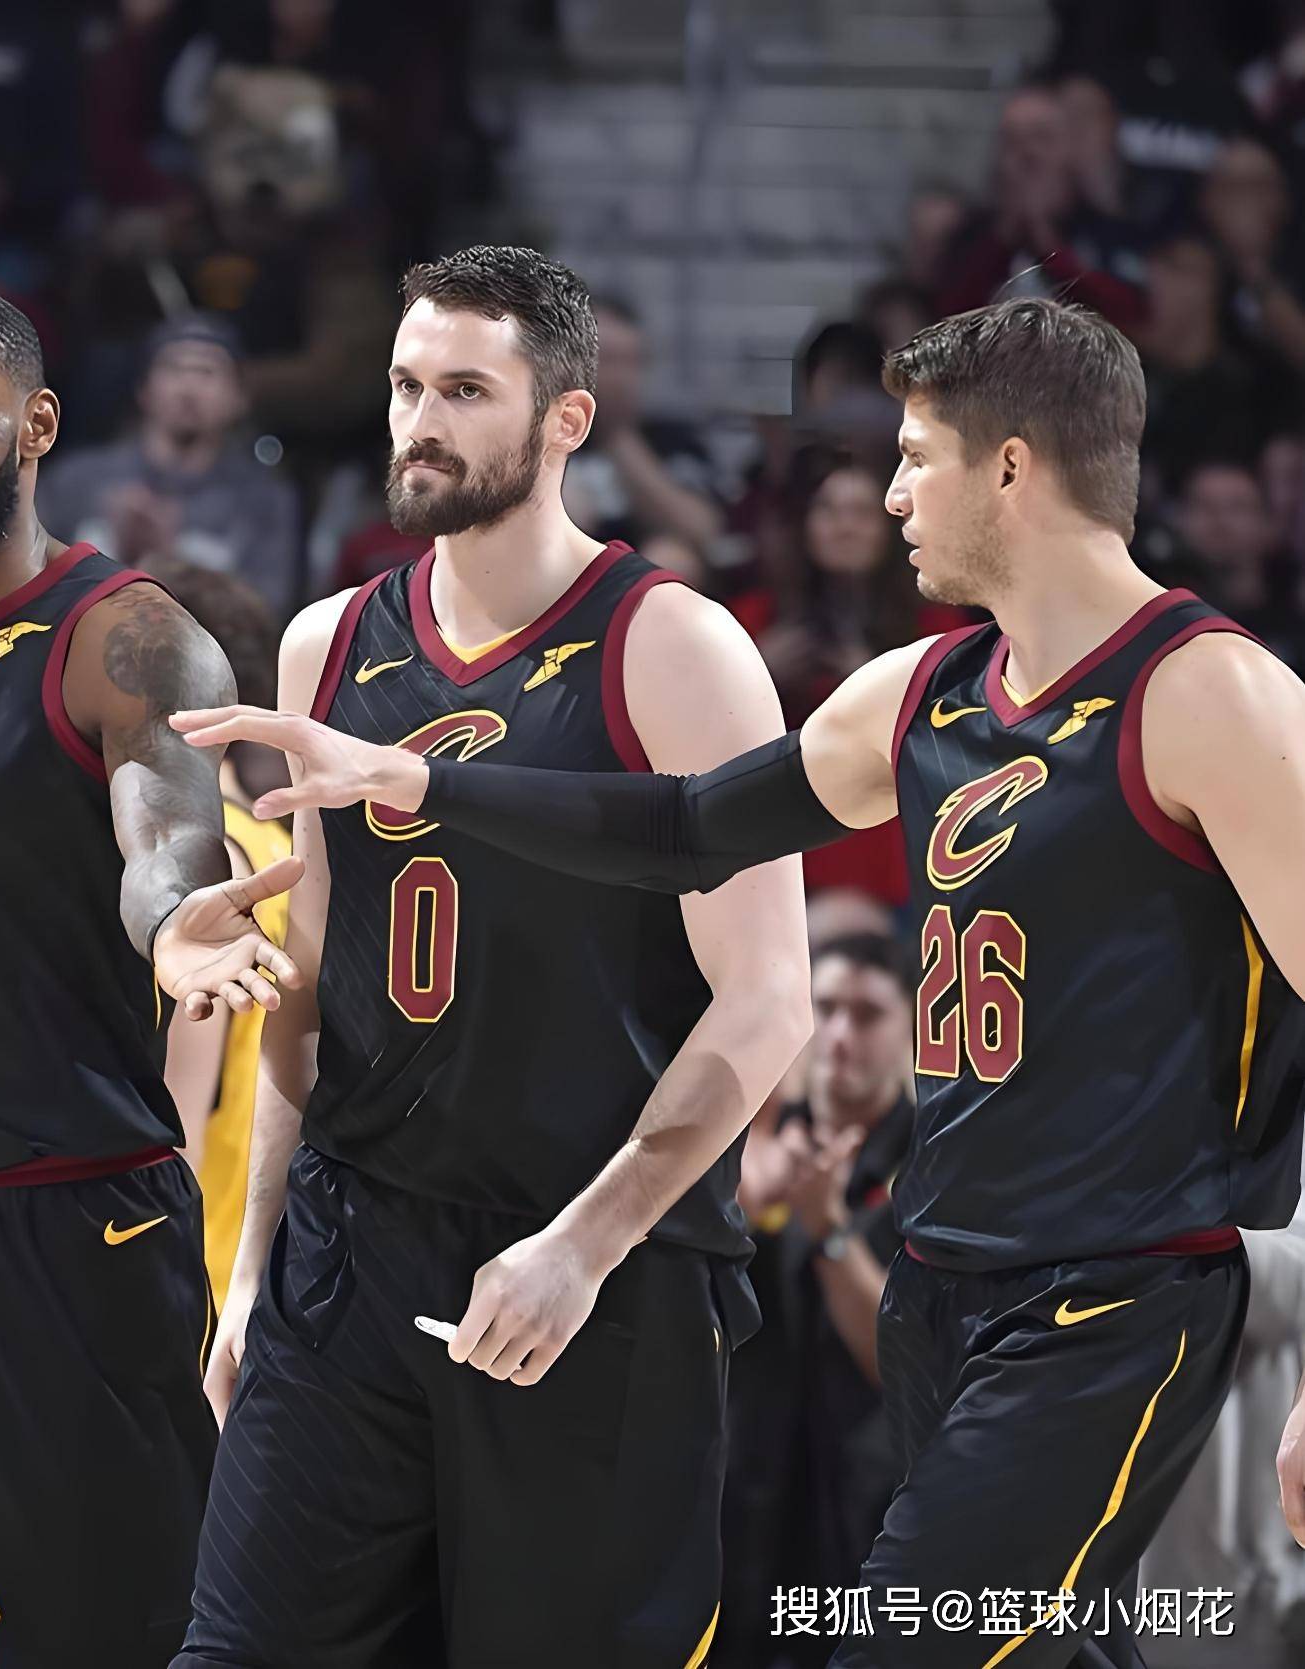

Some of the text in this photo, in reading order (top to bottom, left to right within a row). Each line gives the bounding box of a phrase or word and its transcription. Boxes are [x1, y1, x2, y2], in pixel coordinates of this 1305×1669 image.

[926, 755, 1048, 890] C
[388, 856, 458, 1023] 0
[915, 904, 1026, 1082] 26
